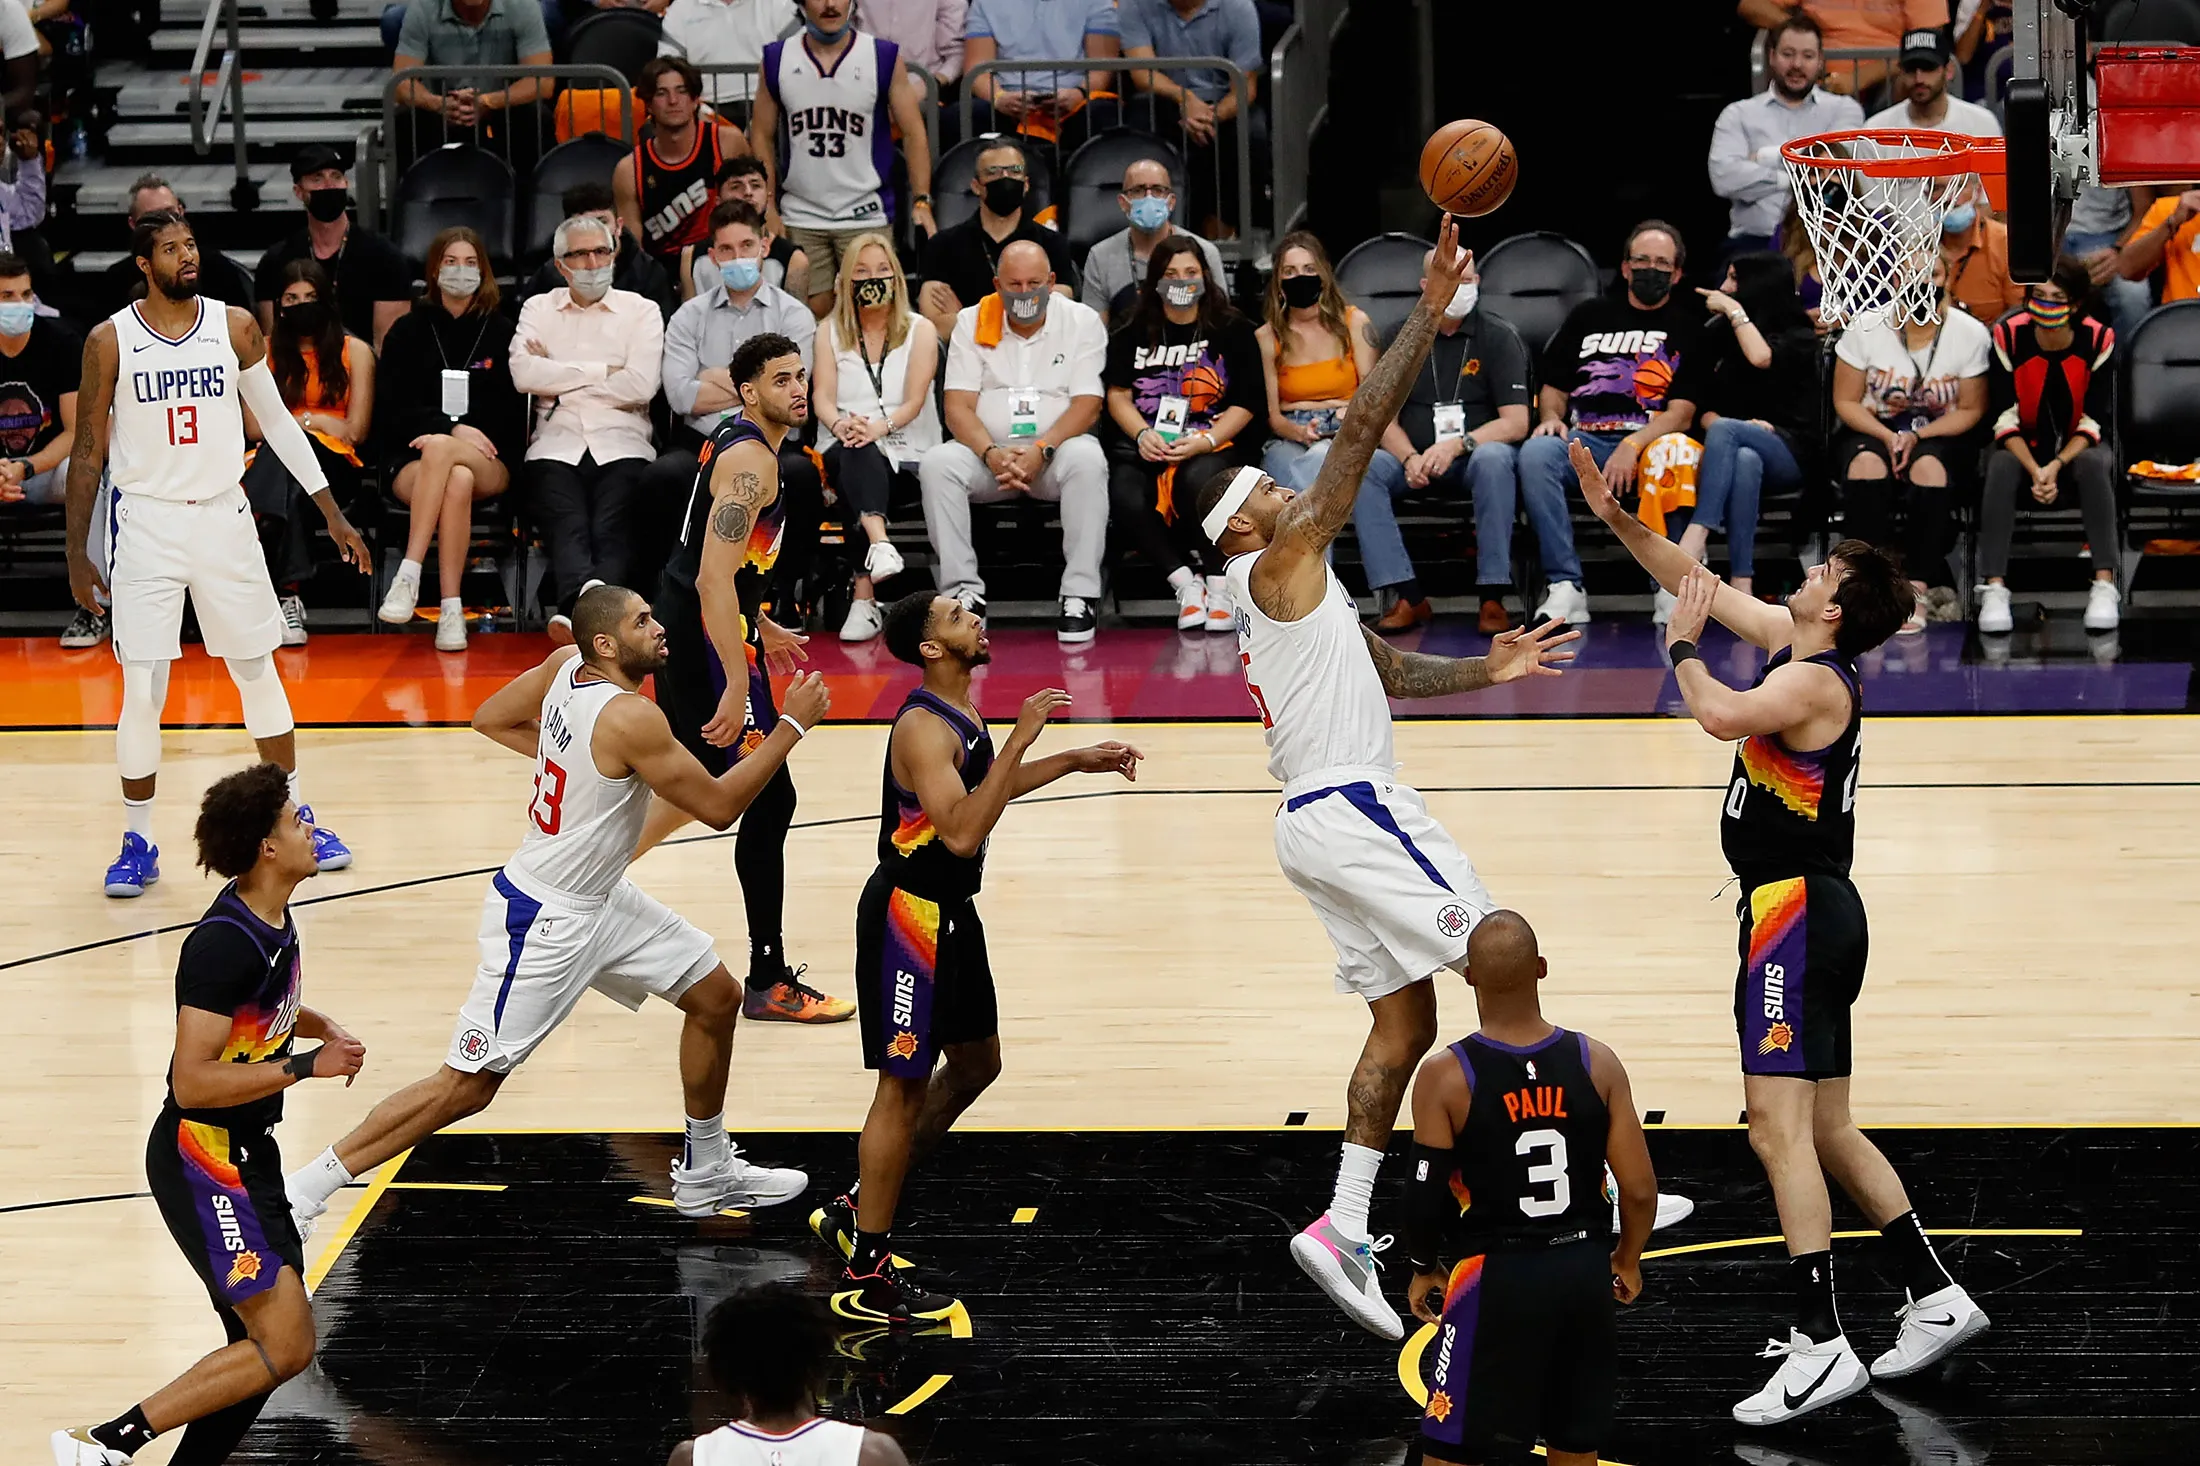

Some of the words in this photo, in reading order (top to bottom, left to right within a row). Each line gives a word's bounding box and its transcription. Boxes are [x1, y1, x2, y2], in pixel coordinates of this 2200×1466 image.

[790, 106, 865, 137] SUNS
[808, 132, 846, 158] 33
[1459, 150, 1512, 206] SPALDING
[644, 178, 708, 241] SUNS
[1134, 339, 1209, 370] SUNS
[1579, 330, 1668, 359] SUNS
[133, 364, 224, 403] CLIPPERS
[167, 405, 198, 446] 13
[893, 969, 915, 1028] SUNS
[1764, 962, 1785, 1021] SUNS
[1503, 1086, 1568, 1123] PAUL
[1515, 1128, 1571, 1218] 3
[211, 1194, 246, 1251] SUNS
[1434, 1323, 1457, 1387] SUNS
